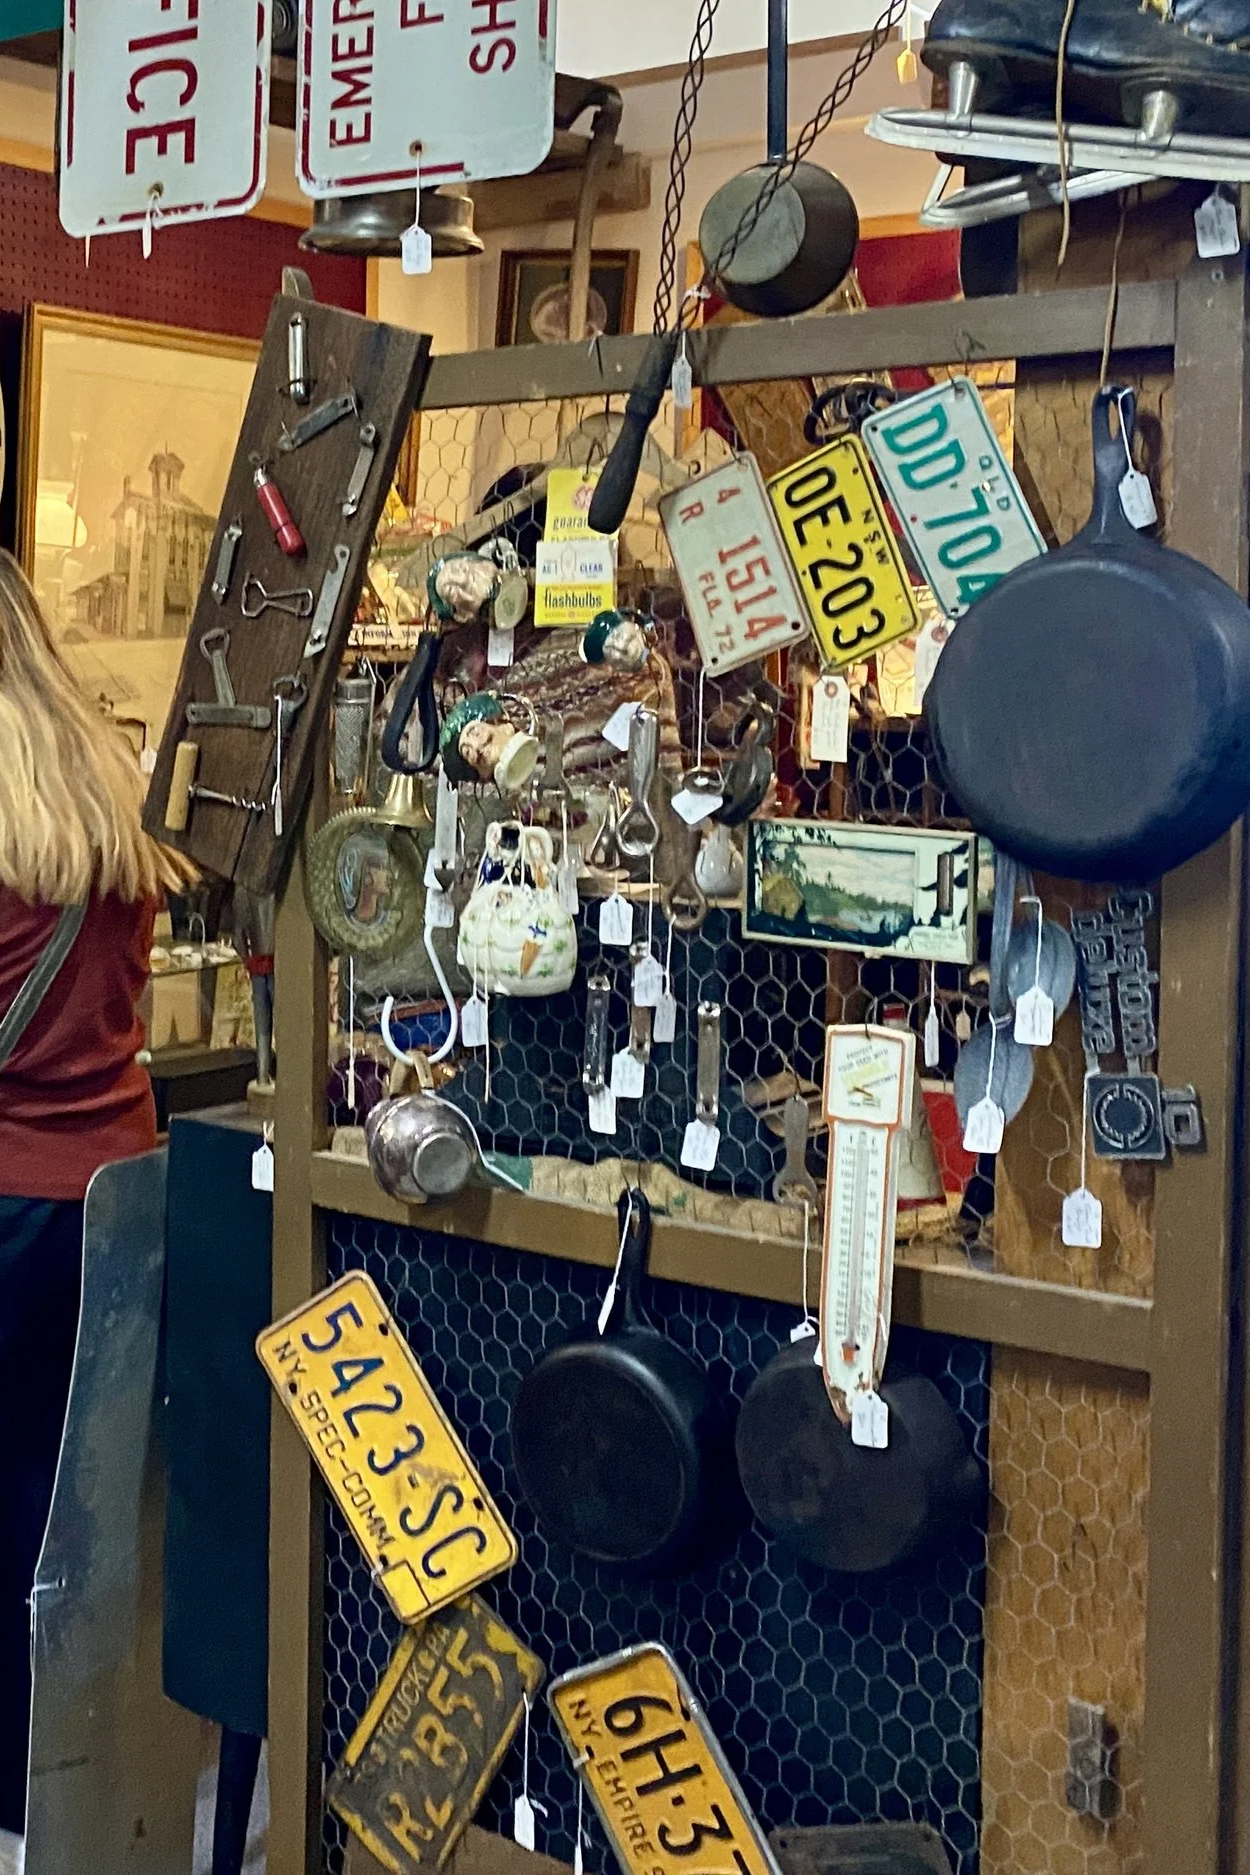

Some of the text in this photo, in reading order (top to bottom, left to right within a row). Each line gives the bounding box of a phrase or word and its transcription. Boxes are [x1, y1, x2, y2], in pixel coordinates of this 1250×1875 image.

[469, 0, 517, 74] SH
[679, 501, 704, 524] R
[717, 486, 741, 504] 4
[860, 508, 890, 566] NSW
[544, 587, 602, 609] flashbulbs
[717, 534, 789, 641] 1514
[711, 625, 735, 654] 72
[274, 1339, 307, 1382] NY
[301, 1301, 487, 1579] 5423-SC
[375, 1660, 431, 1747] TRUCK
[569, 1699, 655, 1857] NY EMPIRE
